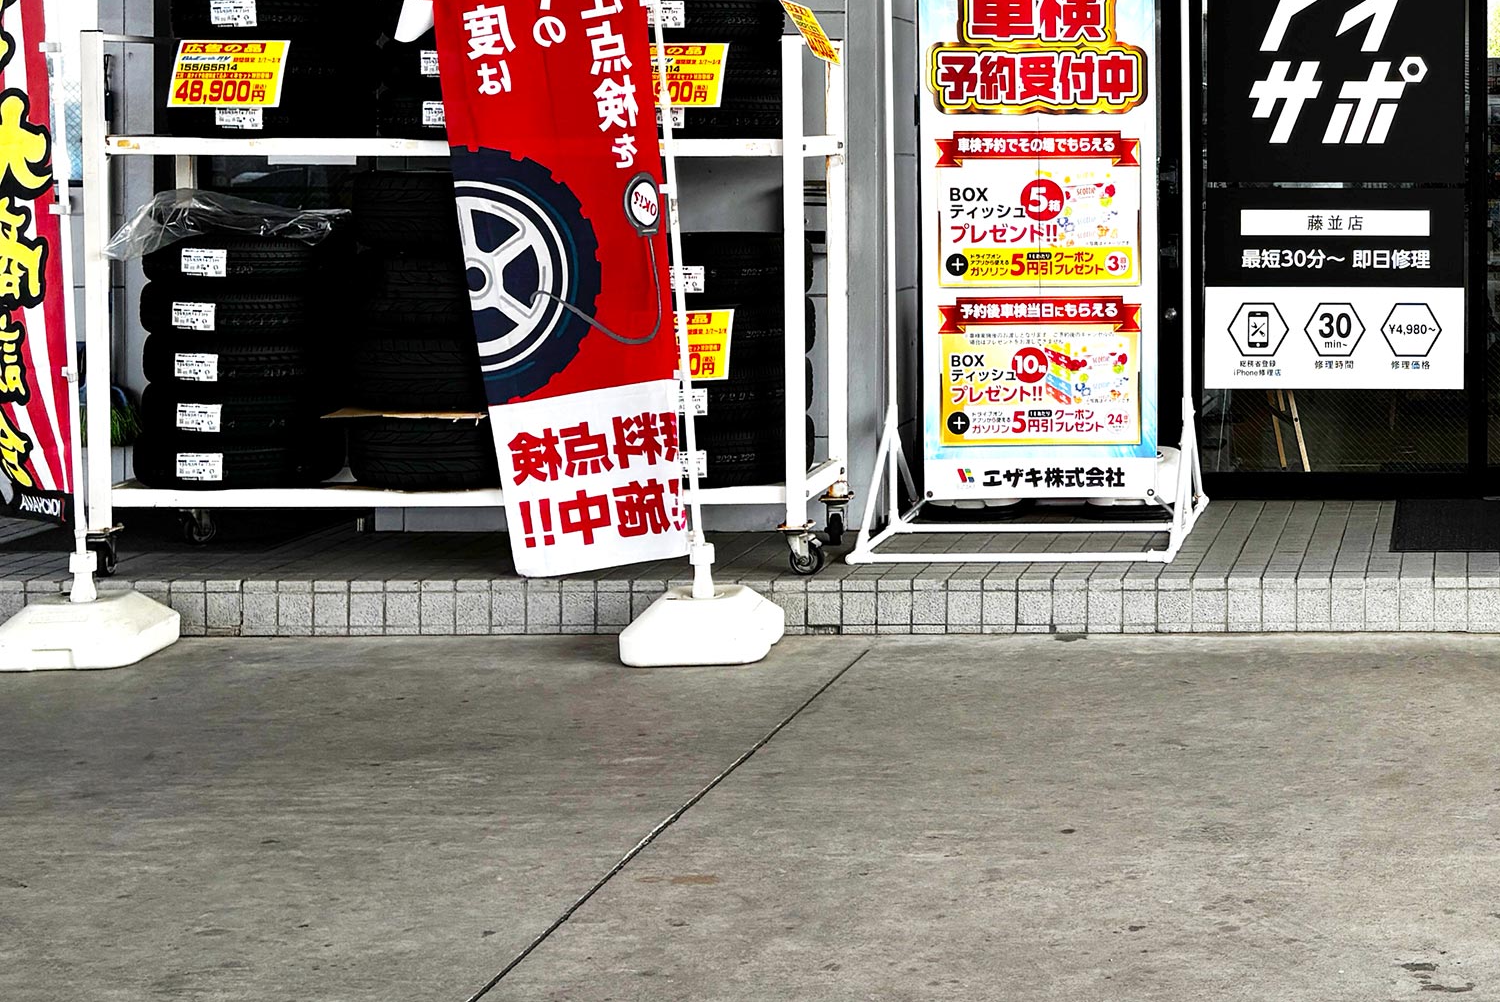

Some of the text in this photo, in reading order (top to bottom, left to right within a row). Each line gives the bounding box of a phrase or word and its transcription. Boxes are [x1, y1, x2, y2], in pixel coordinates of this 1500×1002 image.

[180, 63, 238, 71] 155/65R14
[941, 55, 1137, 101] 予約受付中
[175, 79, 266, 105] 48,900円
[1248, 55, 1429, 144] サポ
[957, 137, 1116, 153] 車検予約でその場でもらえる
[949, 187, 989, 202] BOX
[949, 205, 1027, 219] ティッシュ
[1306, 214, 1364, 232] 藤並店
[1054, 252, 1094, 263] クーポン
[1352, 249, 1431, 270] 即日修理
[970, 267, 1009, 277] ガソリン
[1054, 264, 1104, 276] プレゼント
[959, 302, 1119, 318] 予約後車検当日にもらえる
[1317, 312, 1352, 339] 30
[950, 354, 985, 367] BOX
[1314, 359, 1354, 370] 修理時間
[1391, 359, 1431, 370] 修理価格
[951, 369, 1017, 382] ティッシュ
[1055, 409, 1095, 420] クーポン
[972, 424, 1011, 434] ガソリン
[1055, 421, 1105, 433] プレゼント
[982, 466, 1126, 489] エザキ株式会社
